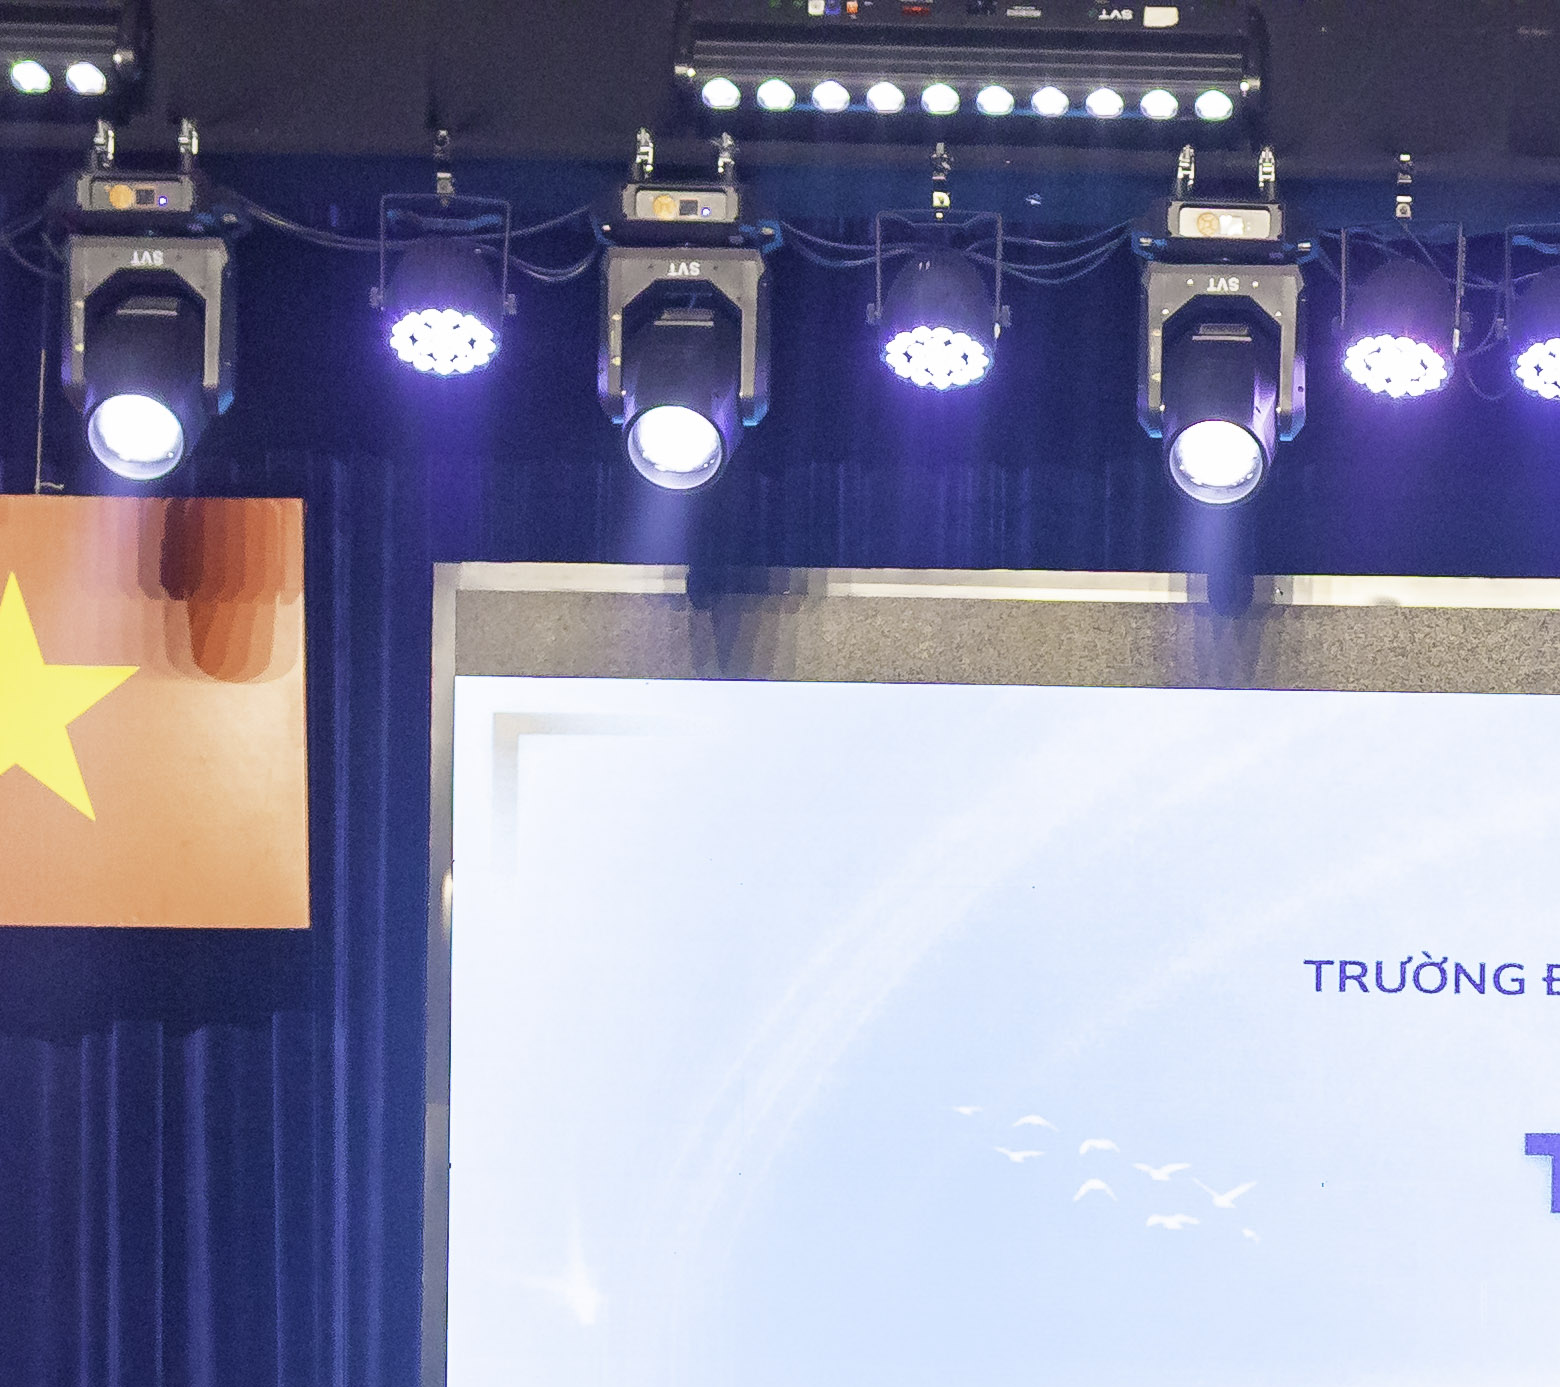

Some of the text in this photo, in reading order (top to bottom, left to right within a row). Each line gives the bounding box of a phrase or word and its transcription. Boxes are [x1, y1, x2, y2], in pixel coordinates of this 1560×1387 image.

[667, 260, 701, 278] SVT
[1205, 275, 1241, 293] SVT
[1304, 951, 1524, 996] TRƯỜNG
